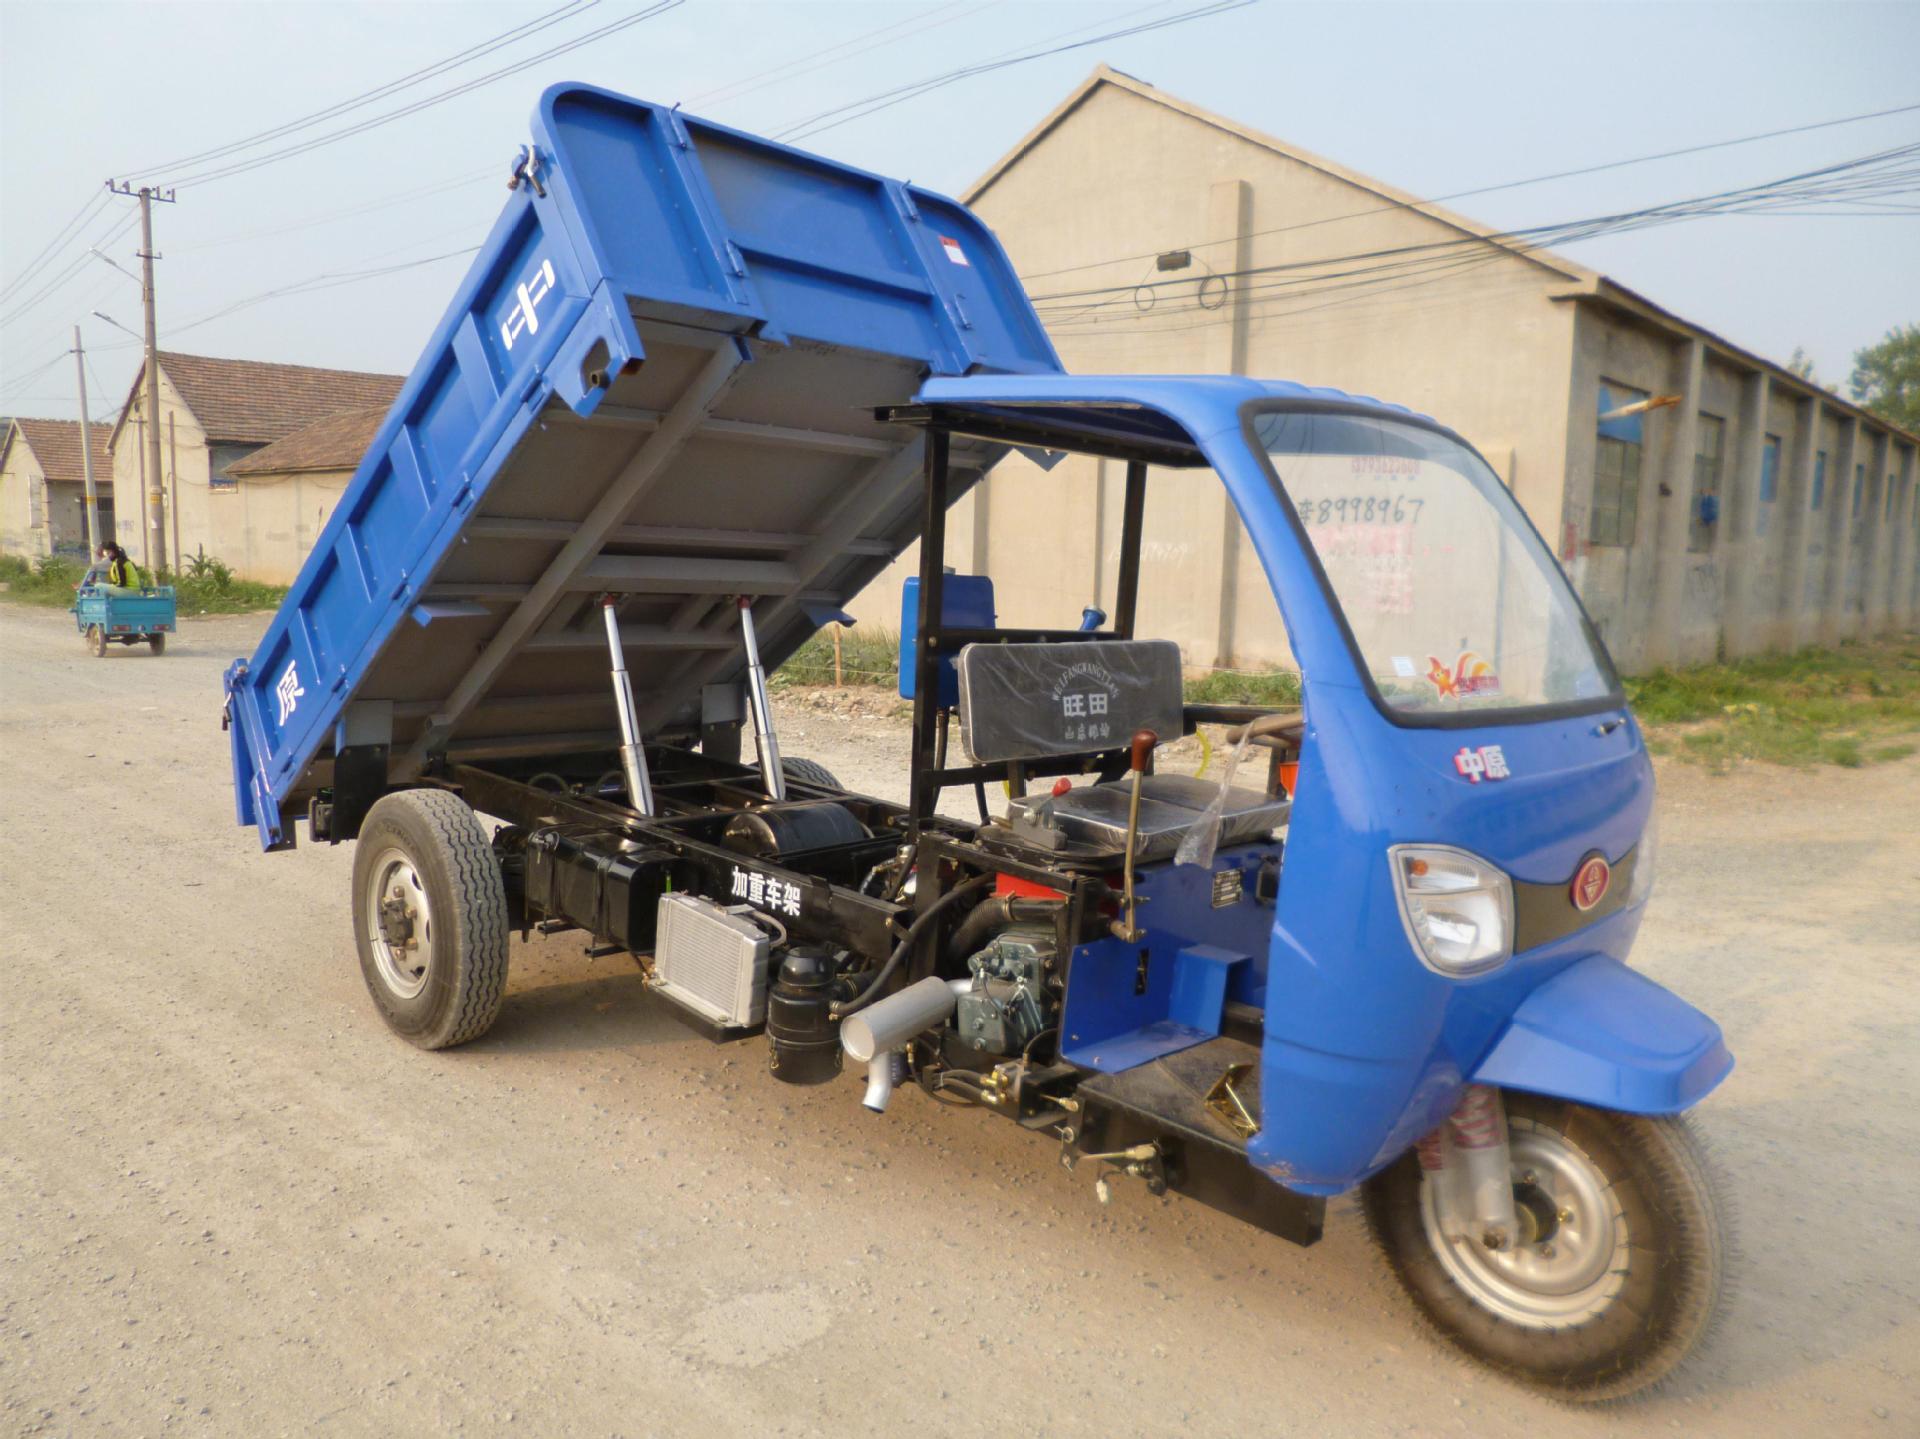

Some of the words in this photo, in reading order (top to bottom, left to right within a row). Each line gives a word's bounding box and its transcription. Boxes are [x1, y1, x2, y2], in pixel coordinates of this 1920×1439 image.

[501, 258, 556, 351] 中
[1063, 692, 1108, 717] 旺田
[731, 865, 801, 917] 加重车架
